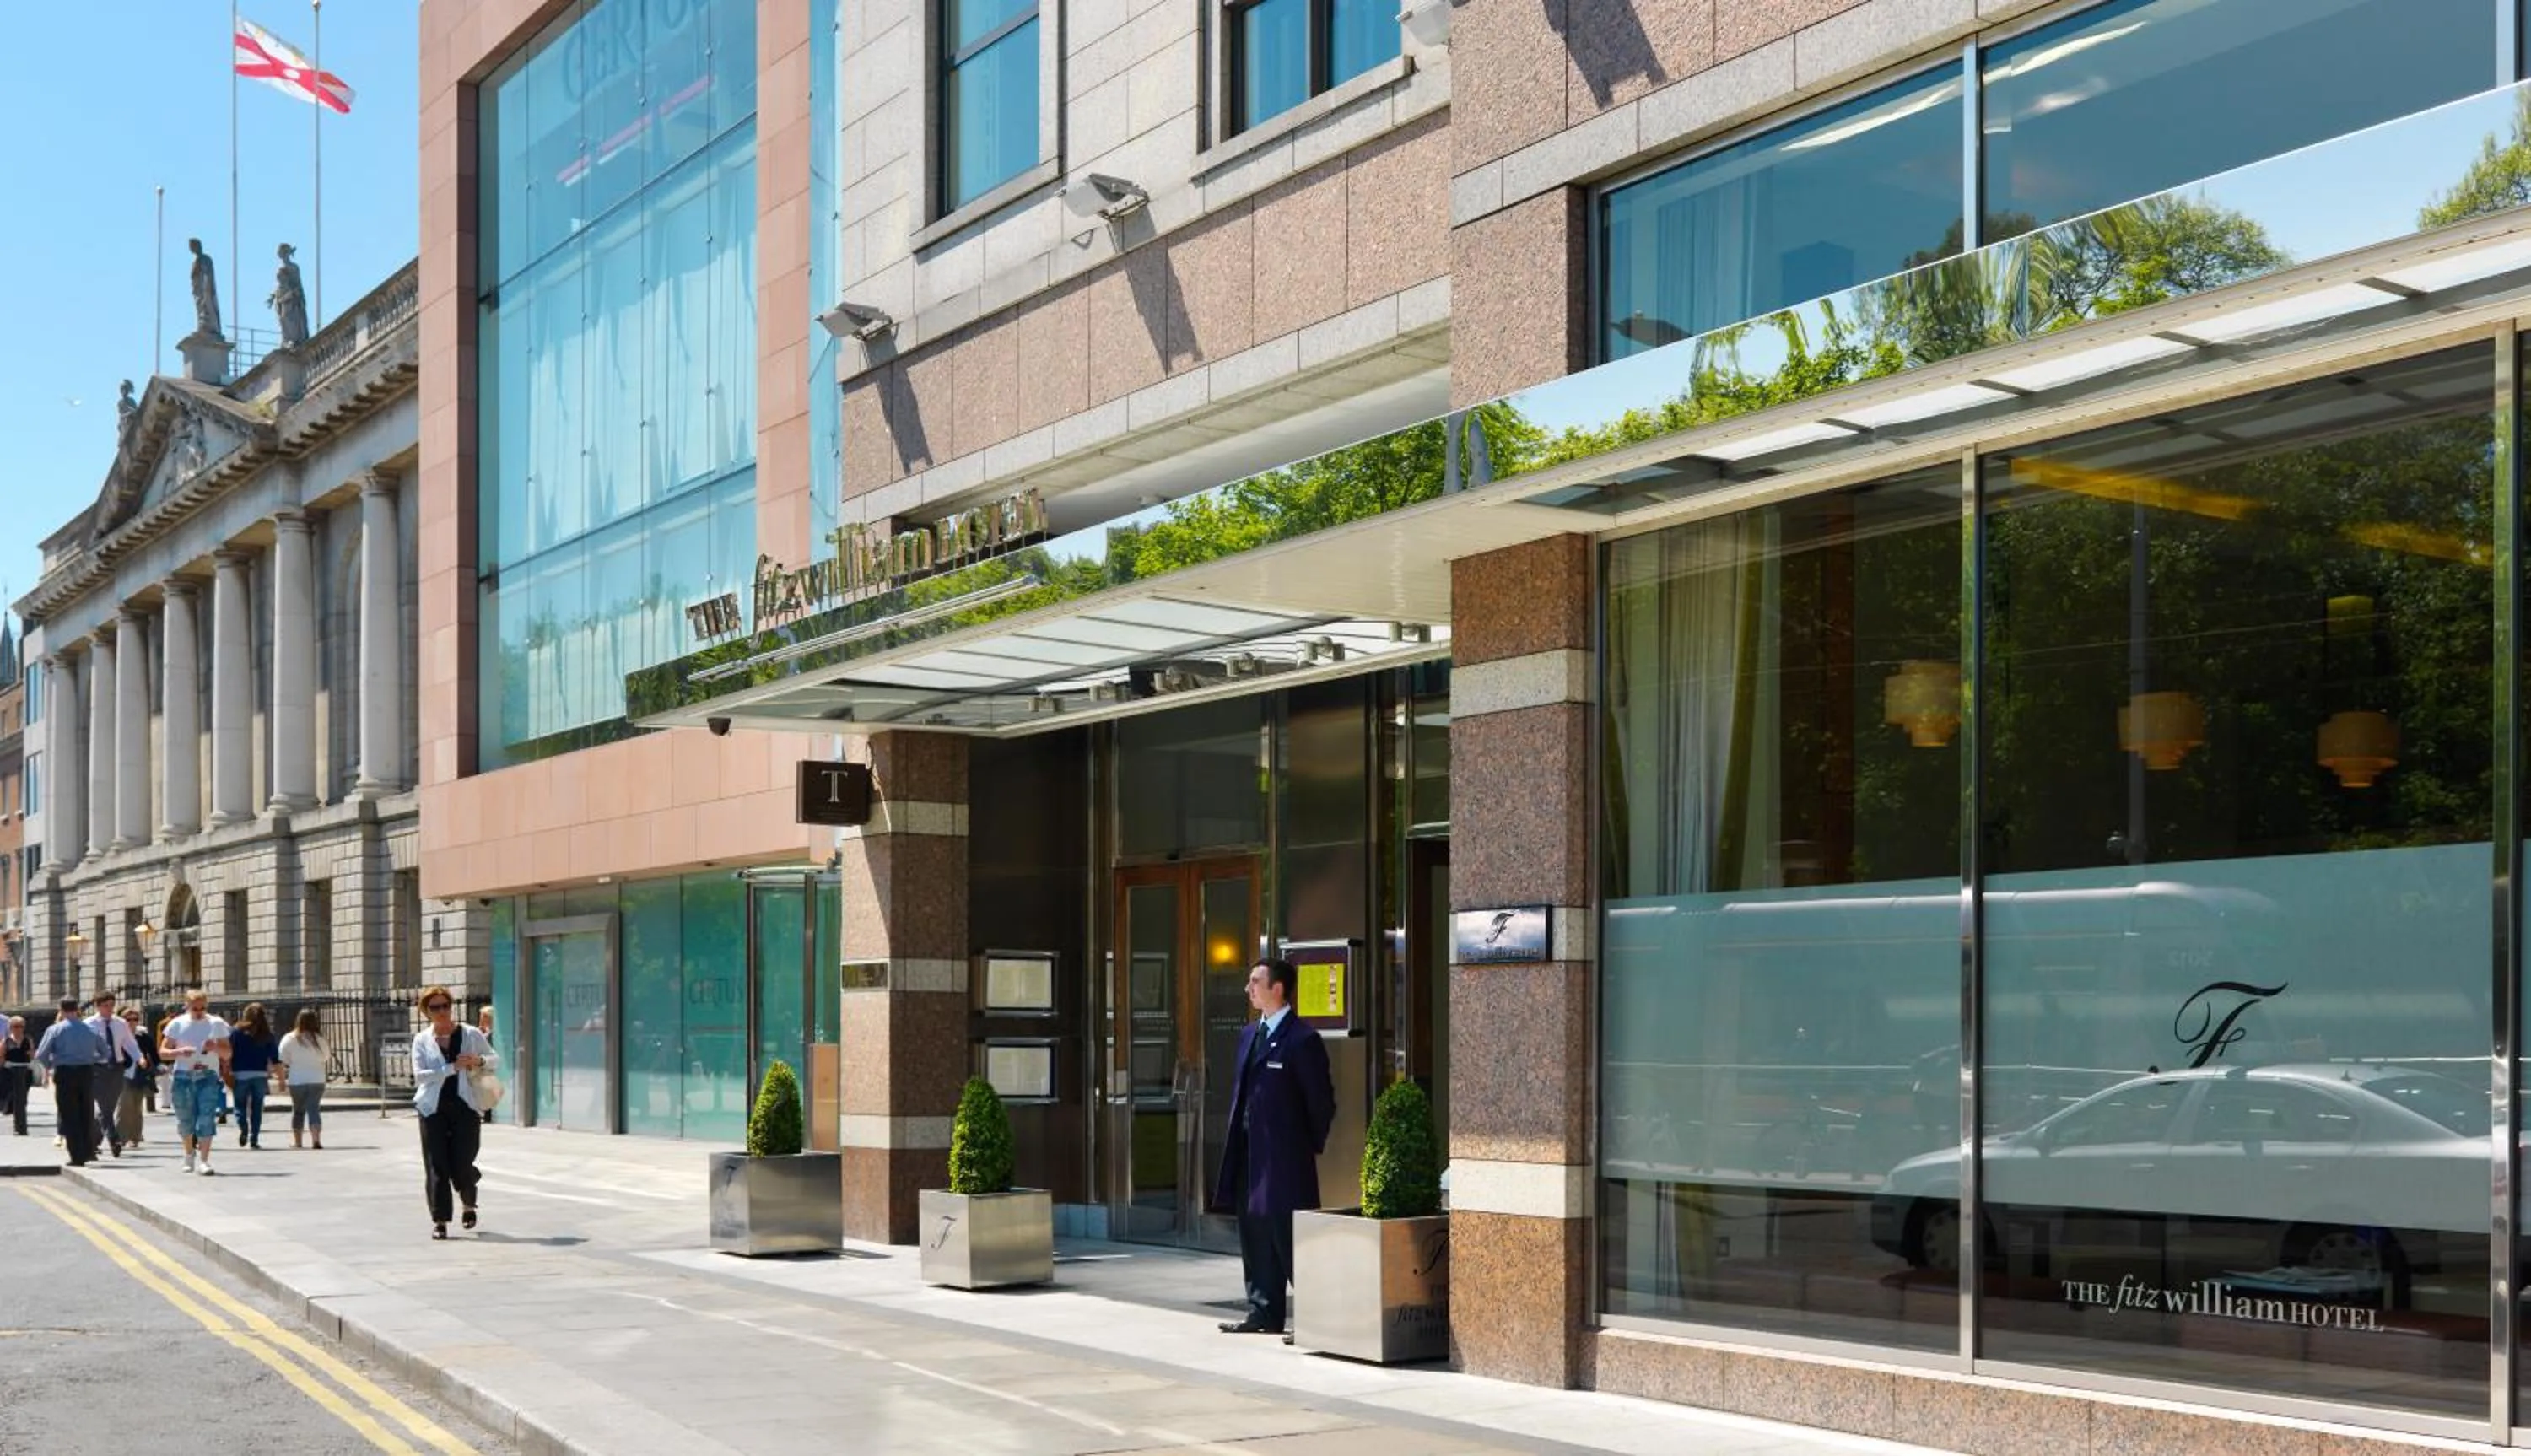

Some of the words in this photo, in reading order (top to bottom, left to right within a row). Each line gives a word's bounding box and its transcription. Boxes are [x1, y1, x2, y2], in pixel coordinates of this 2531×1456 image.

[685, 592, 742, 642] THE
[821, 769, 849, 802] T
[2062, 1279, 2109, 1305] THE
[2289, 1302, 2385, 1333] HOTEL
